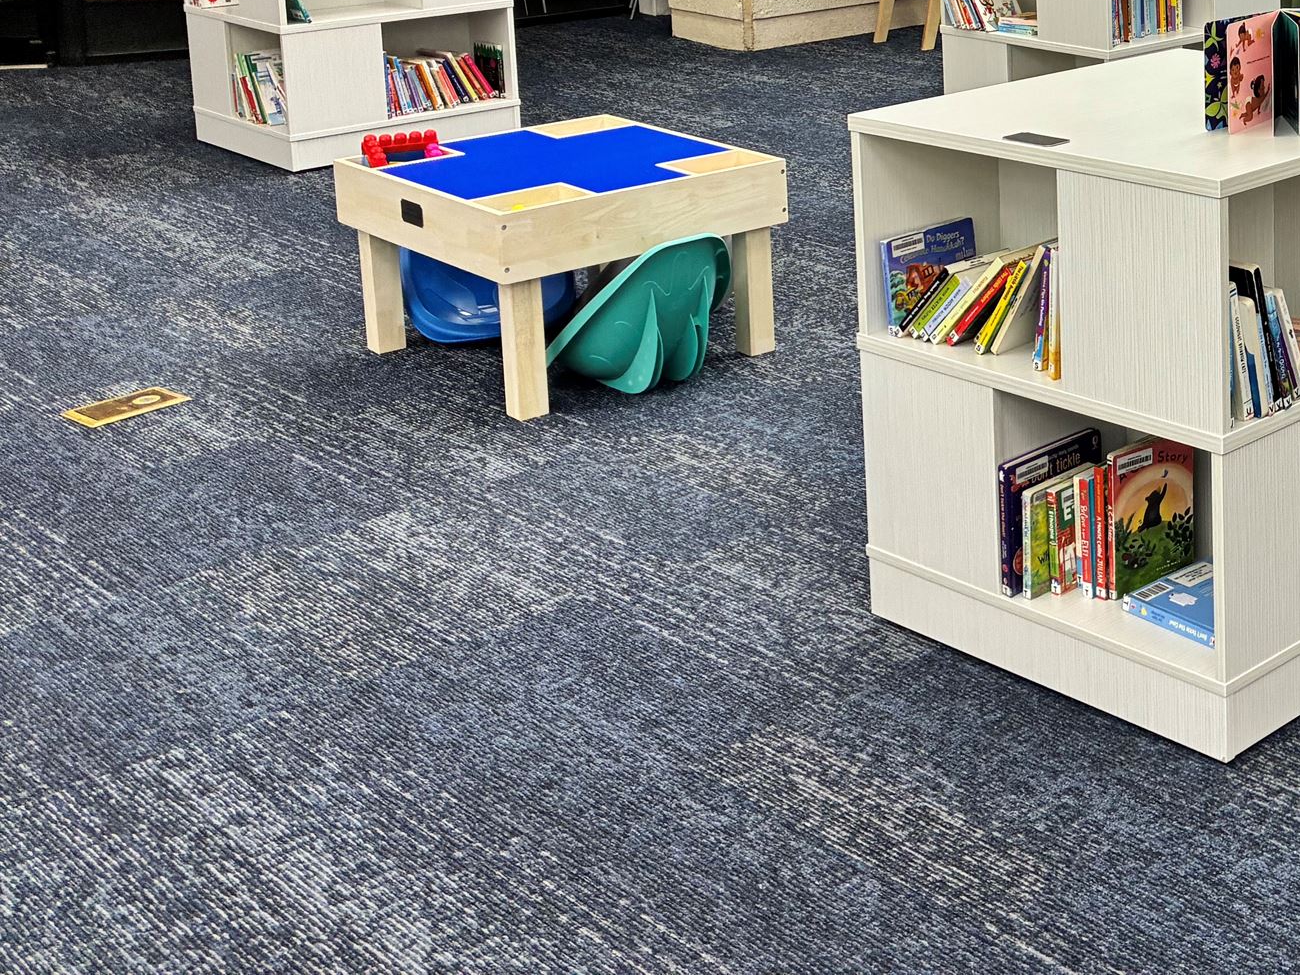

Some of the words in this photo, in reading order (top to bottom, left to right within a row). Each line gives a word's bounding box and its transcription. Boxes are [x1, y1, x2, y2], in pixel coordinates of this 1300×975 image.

[936, 231, 960, 243] Diggers
[1056, 452, 1080, 473] tickle
[1157, 450, 1188, 465] Story
